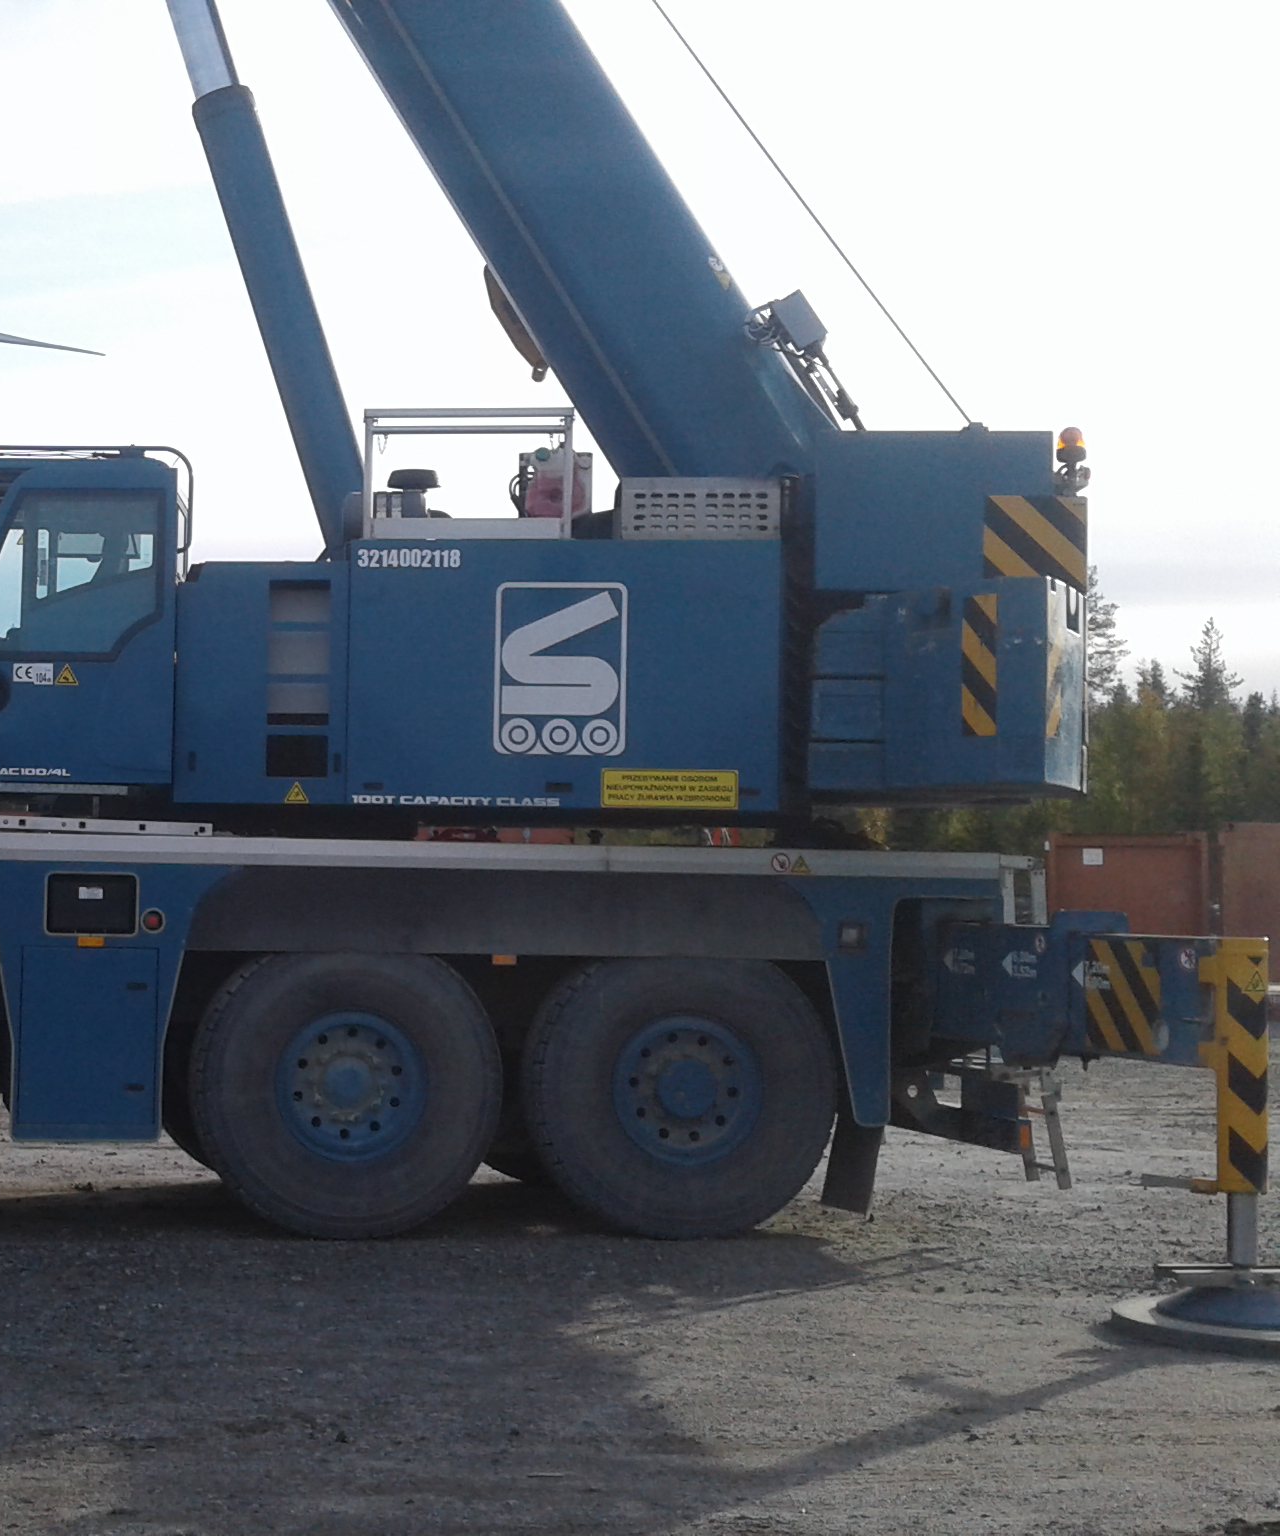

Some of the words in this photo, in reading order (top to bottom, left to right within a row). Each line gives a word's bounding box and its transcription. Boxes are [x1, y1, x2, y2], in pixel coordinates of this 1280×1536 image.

[357, 548, 461, 568] 3214002118
[0, 767, 71, 777] AC100/4L
[352, 795, 396, 805] 100T
[399, 796, 492, 806] CAPACITY
[496, 797, 561, 807] CLASS
